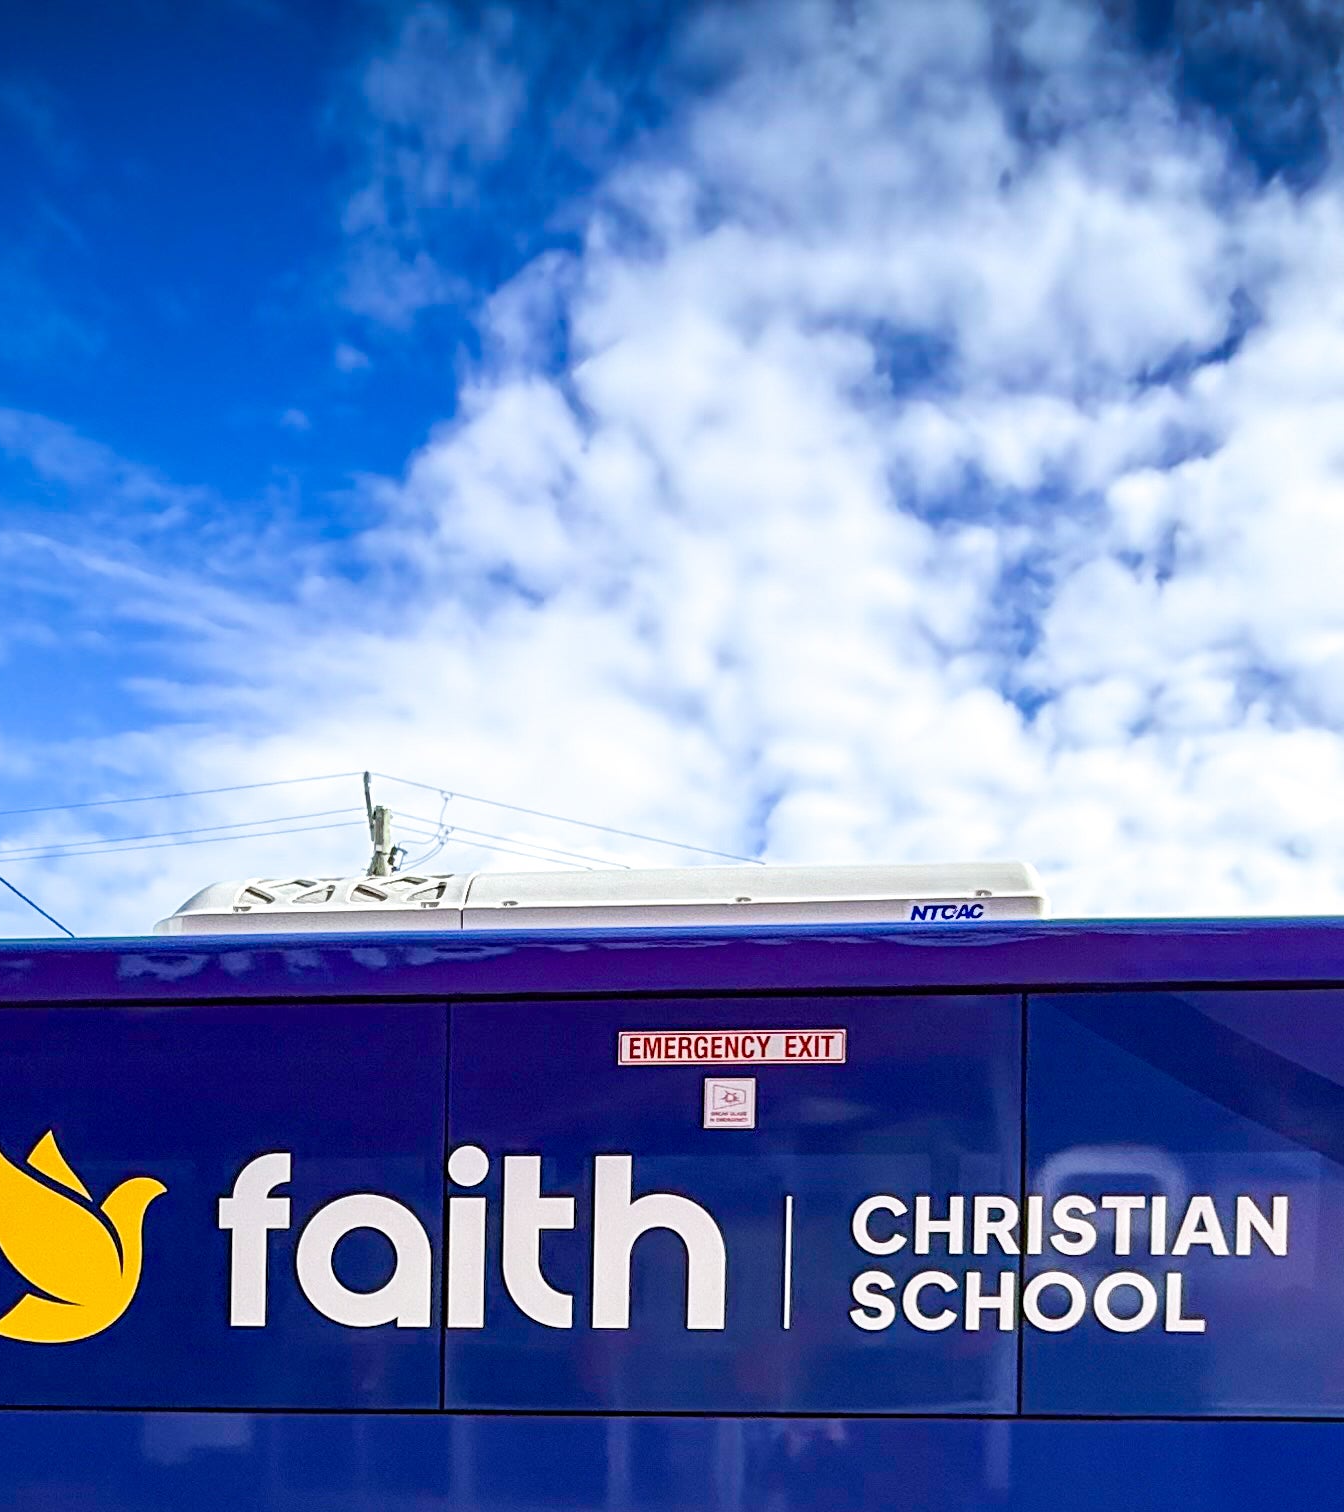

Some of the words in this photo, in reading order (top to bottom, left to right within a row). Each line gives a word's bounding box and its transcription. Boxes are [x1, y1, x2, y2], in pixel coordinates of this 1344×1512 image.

[629, 1036, 771, 1060] EMERGENCY
[784, 1035, 835, 1058] EXIT
[219, 1146, 727, 1329] faith
[852, 1195, 1289, 1257] CHRISTIAN
[849, 1271, 1206, 1333] SCHOOL
